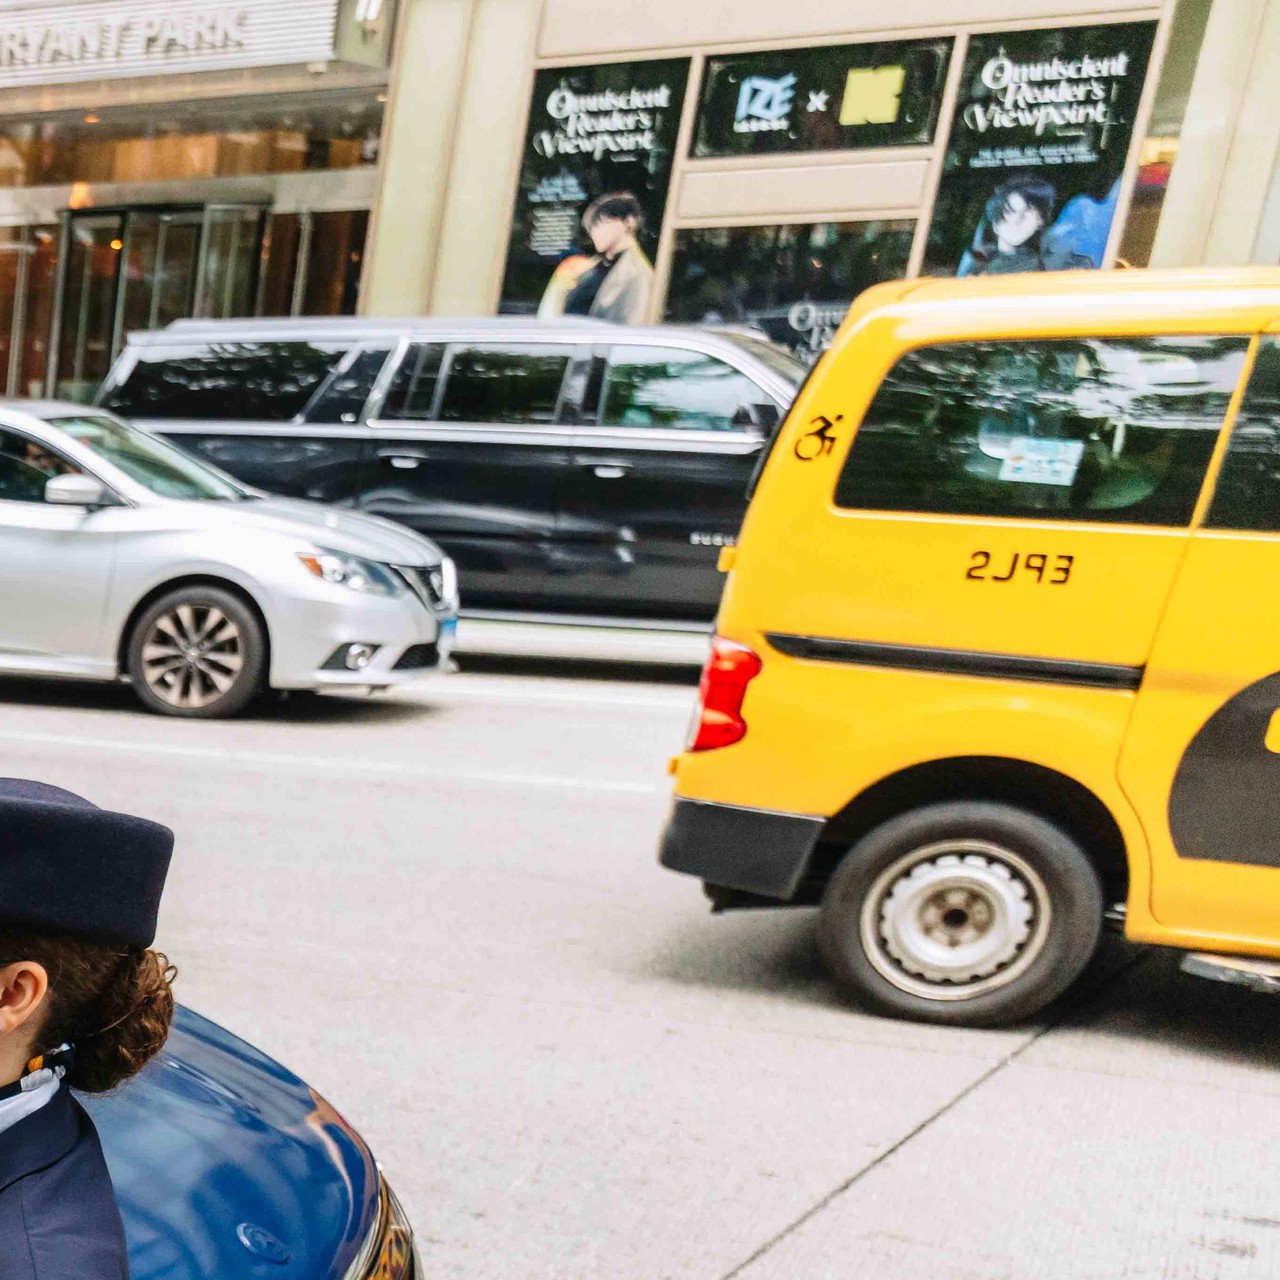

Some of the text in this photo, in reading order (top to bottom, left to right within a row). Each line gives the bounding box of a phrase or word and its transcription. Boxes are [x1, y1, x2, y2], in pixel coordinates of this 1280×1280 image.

[142, 9, 247, 55] PARK
[980, 50, 1130, 90] Omniscient
[546, 83, 671, 119] Omniscient
[998, 78, 1107, 110] Reader's
[963, 101, 1109, 136] Viewpoint
[532, 128, 657, 161] Viewpoint
